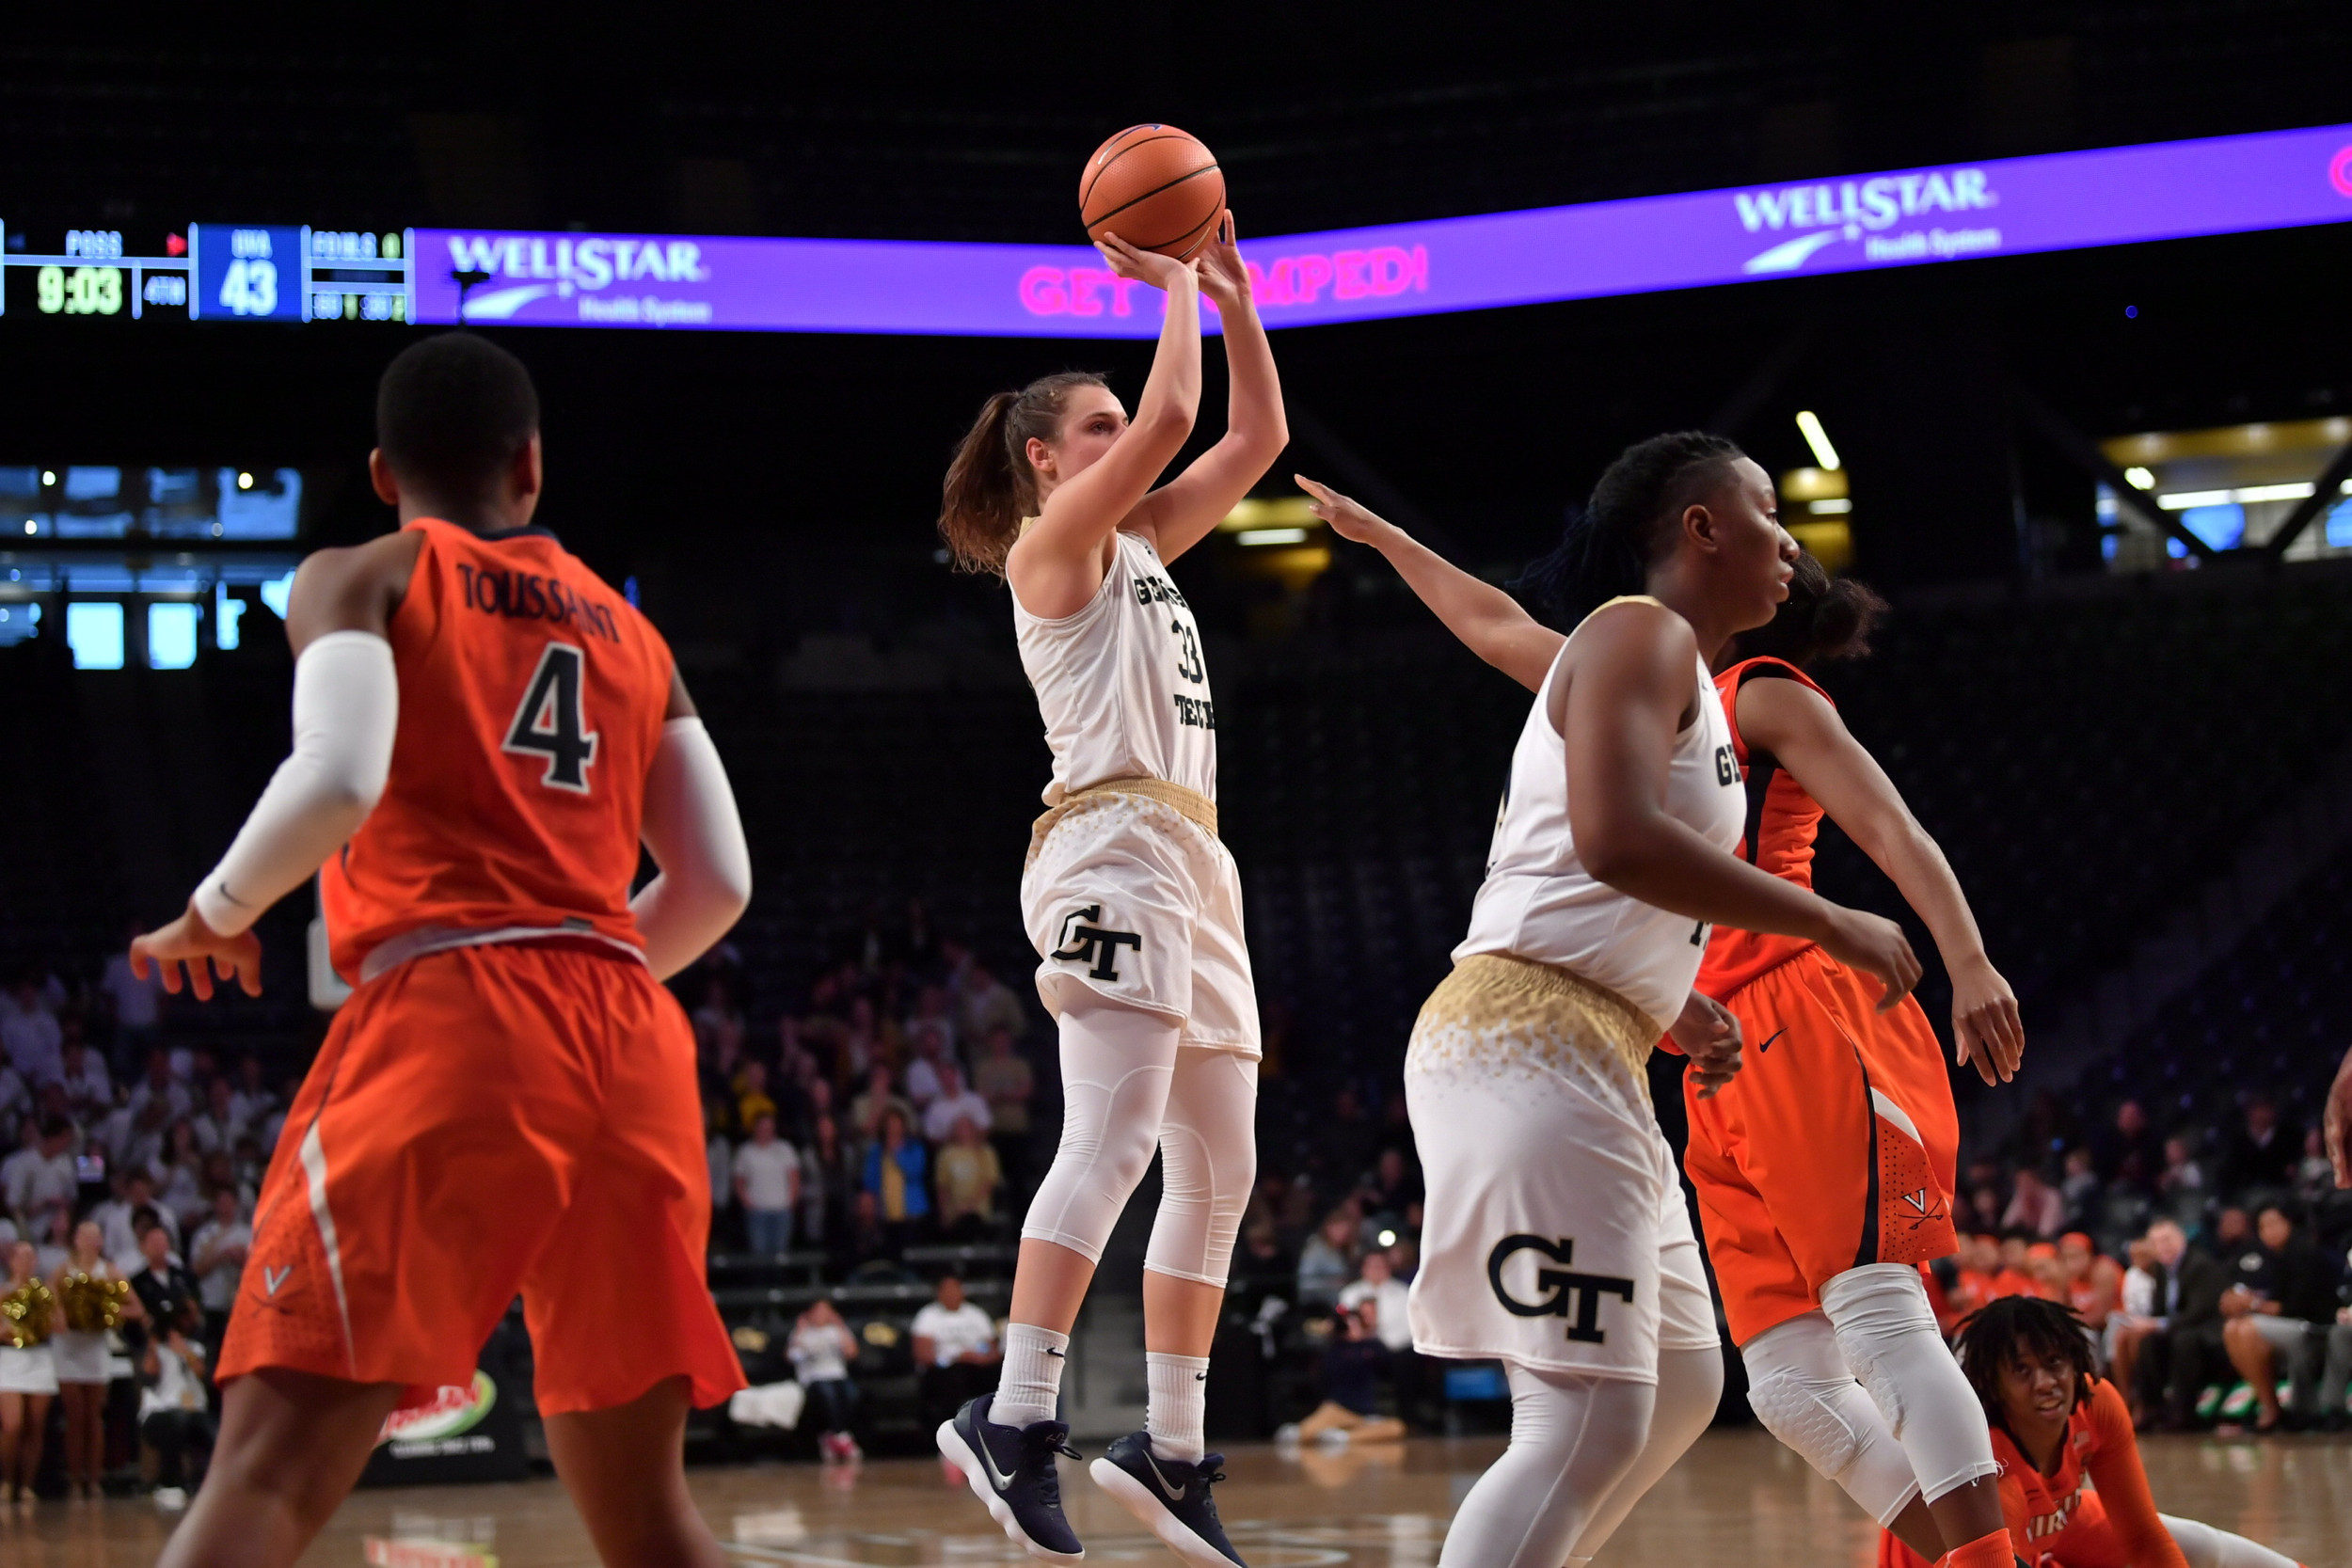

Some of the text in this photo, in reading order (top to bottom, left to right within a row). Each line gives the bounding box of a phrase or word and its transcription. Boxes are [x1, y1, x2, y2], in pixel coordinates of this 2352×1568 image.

[1735, 168, 1988, 233] WELLSTAR
[65, 230, 122, 260] POSS
[447, 235, 706, 291] WELLSTAR
[1929, 228, 2003, 259] System
[38, 264, 123, 315] 9:03
[218, 258, 278, 317] 43
[578, 293, 713, 327] Health System
[1019, 264, 1139, 318] GET
[501, 641, 599, 796] 4
[1050, 905, 1141, 981] GT
[1487, 1234, 1634, 1343] GT
